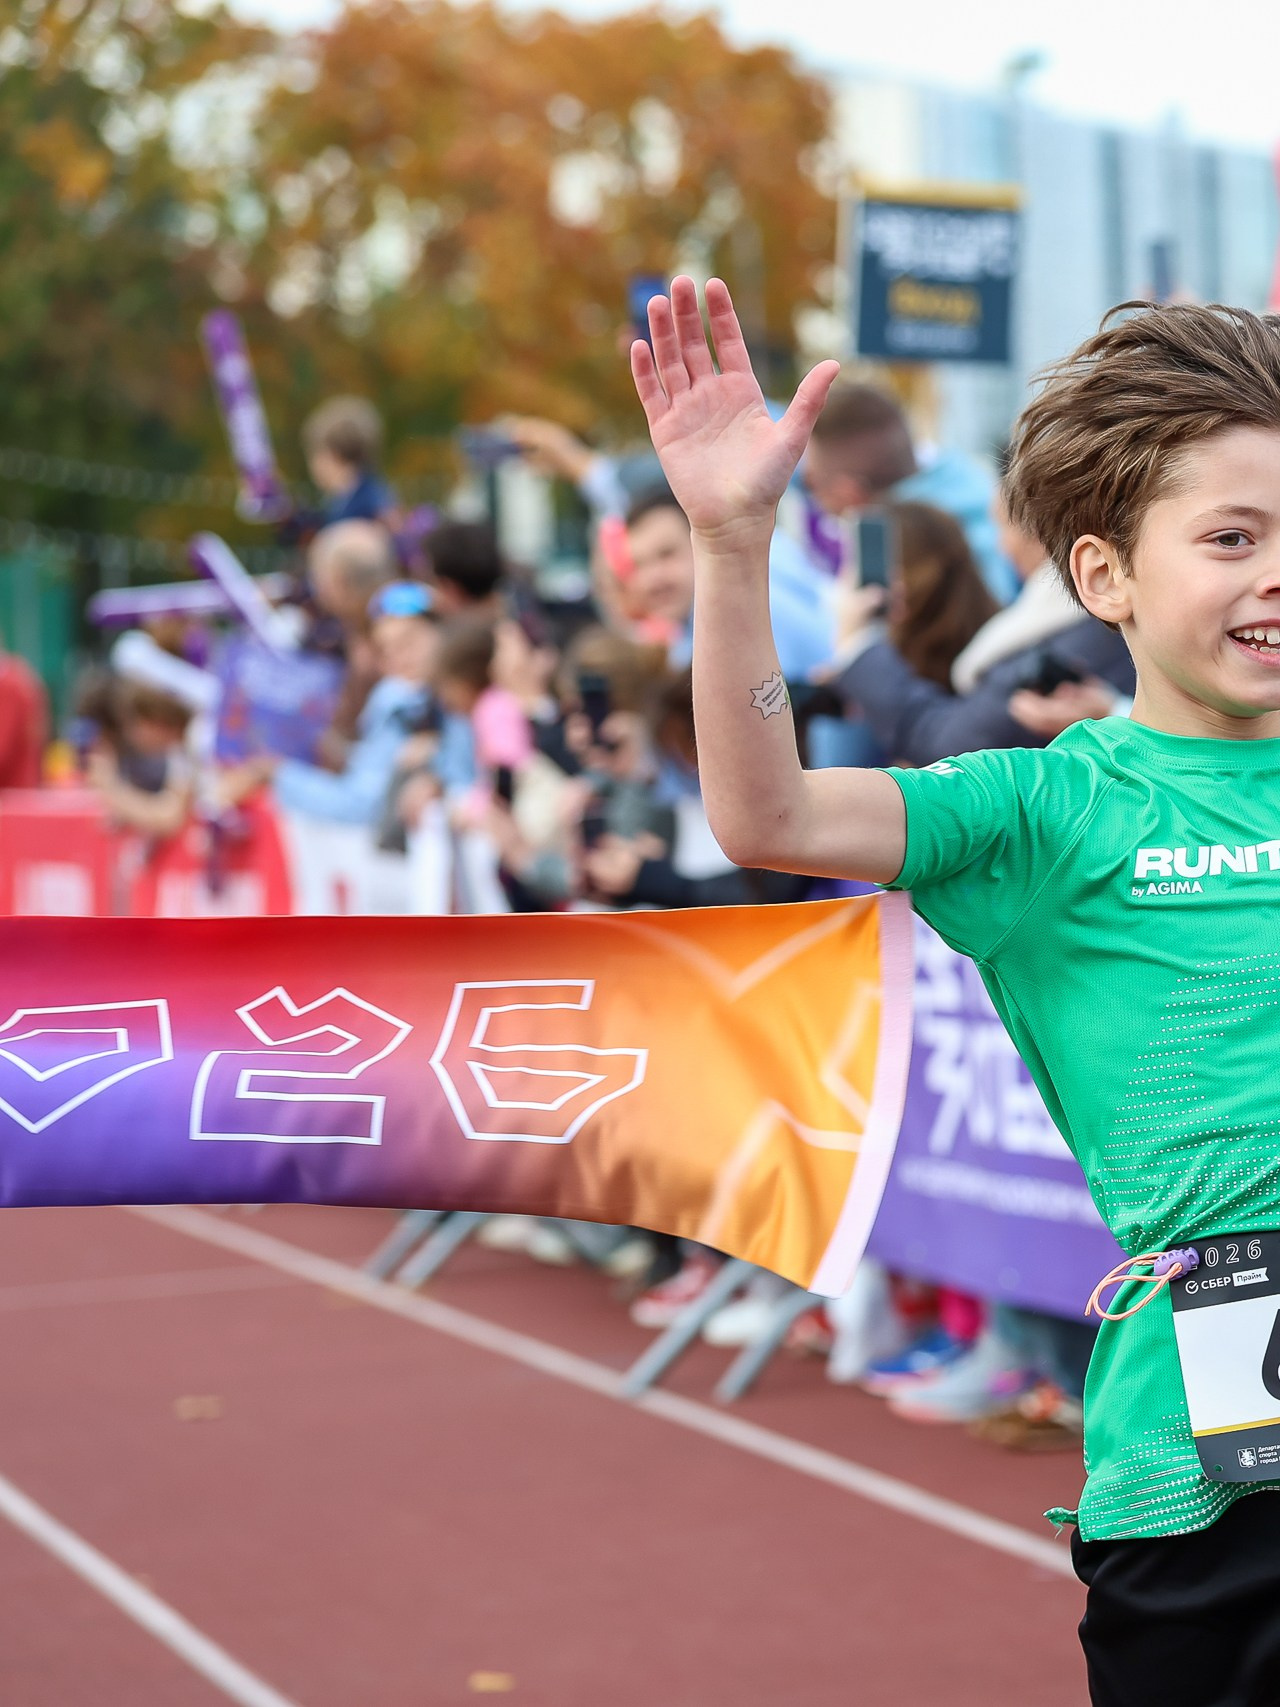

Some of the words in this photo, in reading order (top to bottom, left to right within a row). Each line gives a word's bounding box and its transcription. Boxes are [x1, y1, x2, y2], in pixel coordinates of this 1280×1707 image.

[1131, 886, 1144, 898] by
[1146, 880, 1204, 896] AGIMA
[1201, 1276, 1232, 1290] СБЕР
[1236, 1272, 1262, 1283] Прайм
